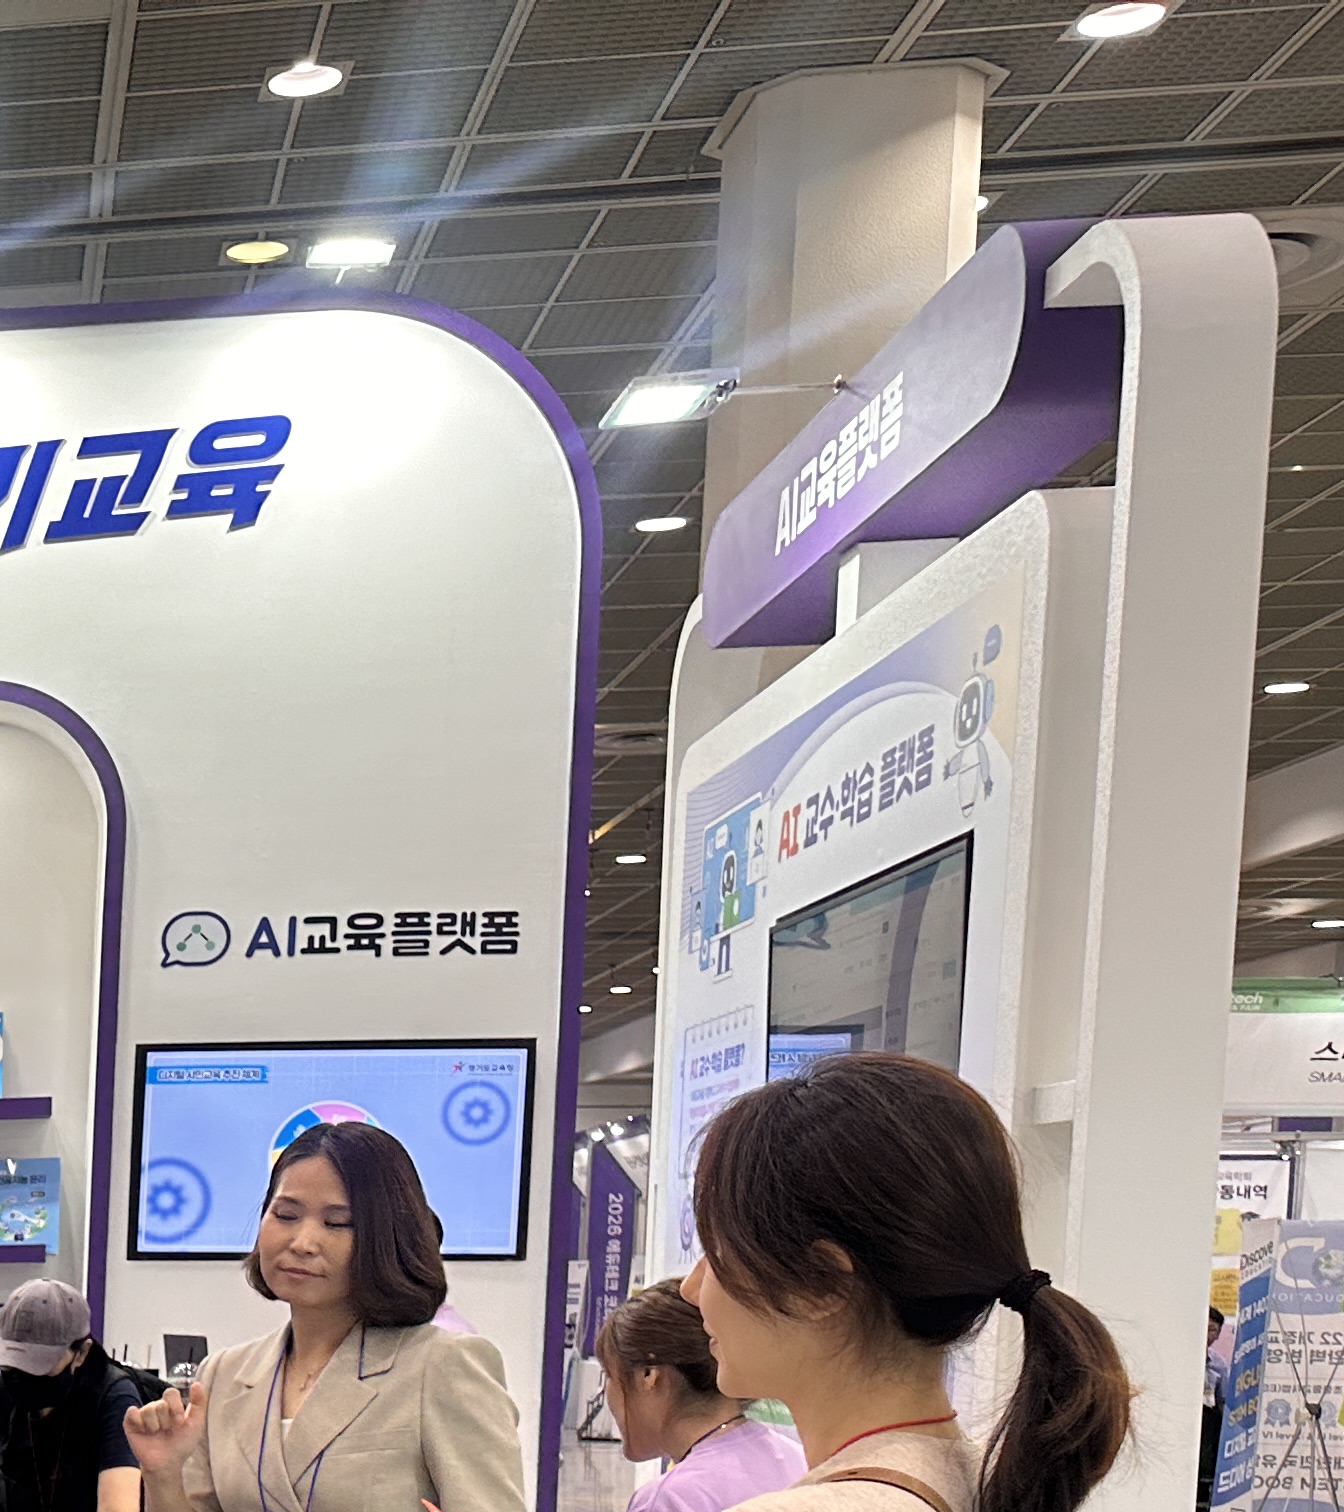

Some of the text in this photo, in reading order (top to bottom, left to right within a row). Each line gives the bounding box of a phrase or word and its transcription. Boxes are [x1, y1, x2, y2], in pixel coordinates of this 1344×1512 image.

[774, 371, 904, 558] AI교육플랫폼
[777, 802, 802, 864] AI
[878, 723, 935, 813] 플랫폼
[245, 911, 521, 958] AI교육플랫폼
[1310, 1041, 1344, 1062] 스
[607, 1192, 624, 1236] 2026
[1217, 1185, 1268, 1200] 동내역
